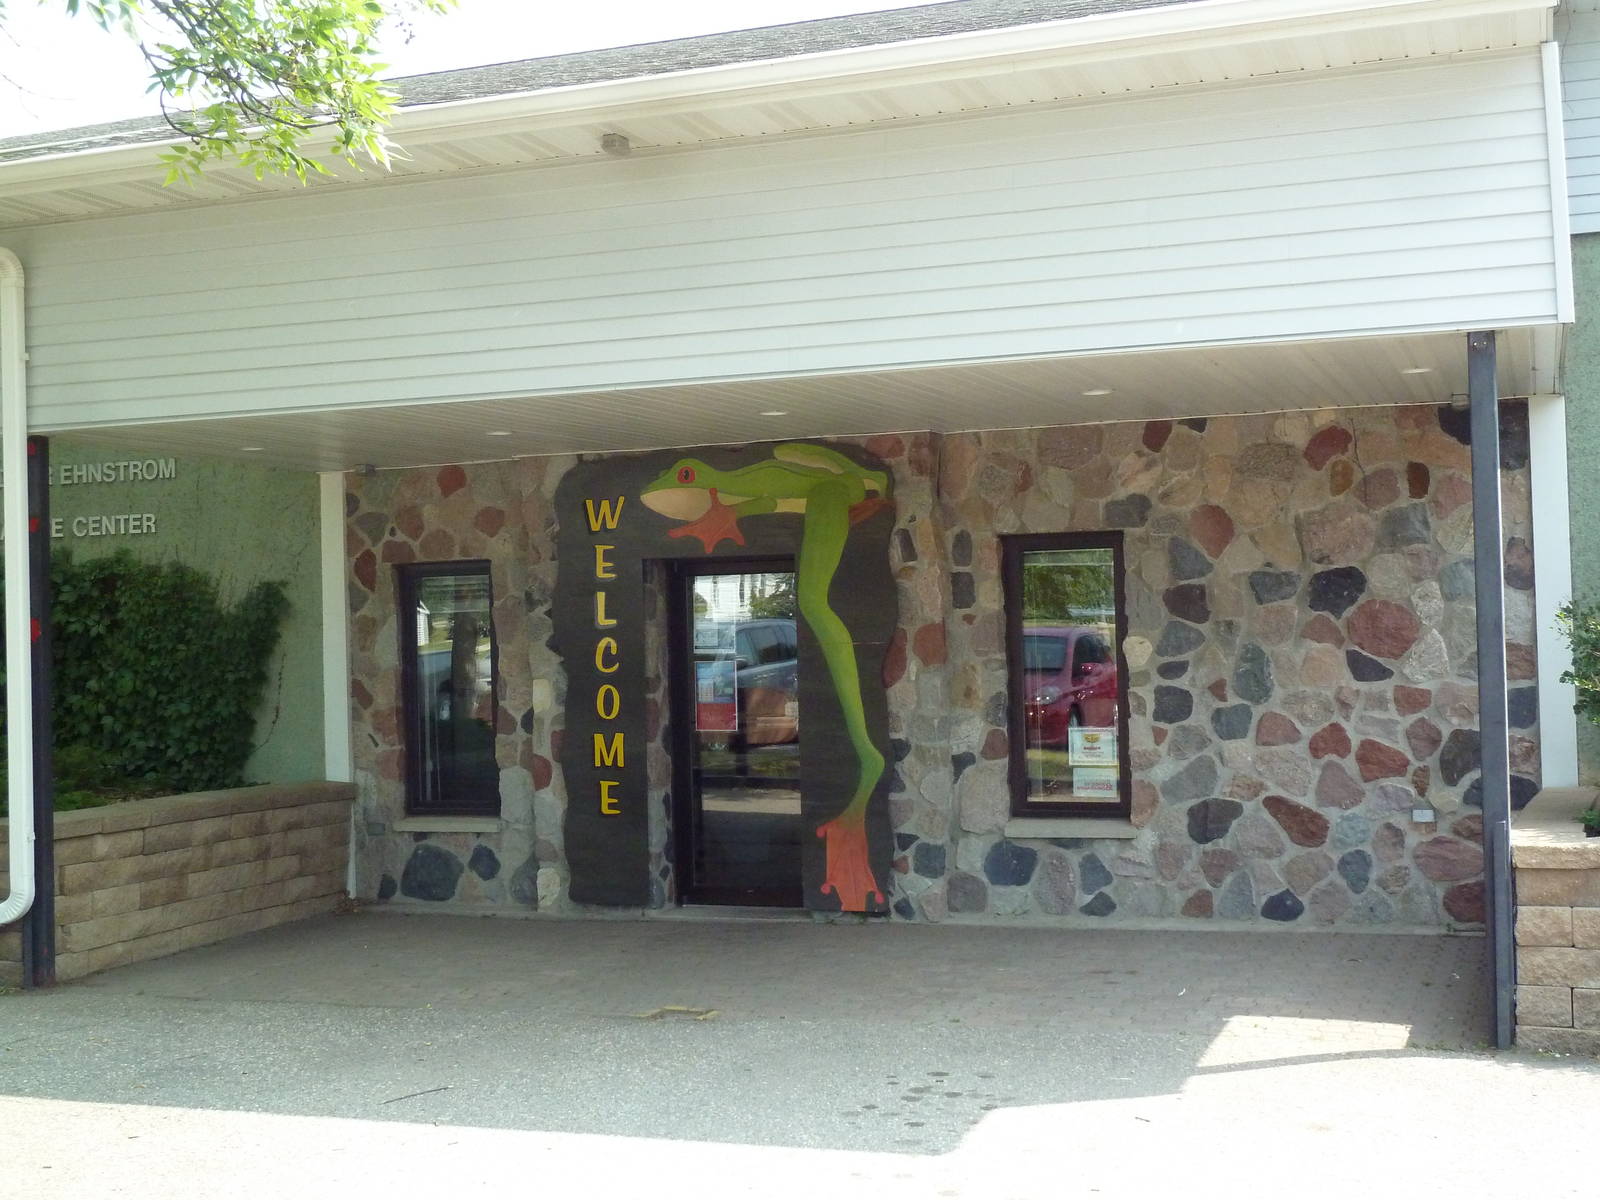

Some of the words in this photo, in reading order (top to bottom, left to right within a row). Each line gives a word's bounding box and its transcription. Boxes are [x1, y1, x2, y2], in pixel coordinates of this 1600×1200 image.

[60, 458, 177, 485] EHNSTROM
[72, 513, 157, 537] CENTER
[584, 495, 626, 815] WELCOME
